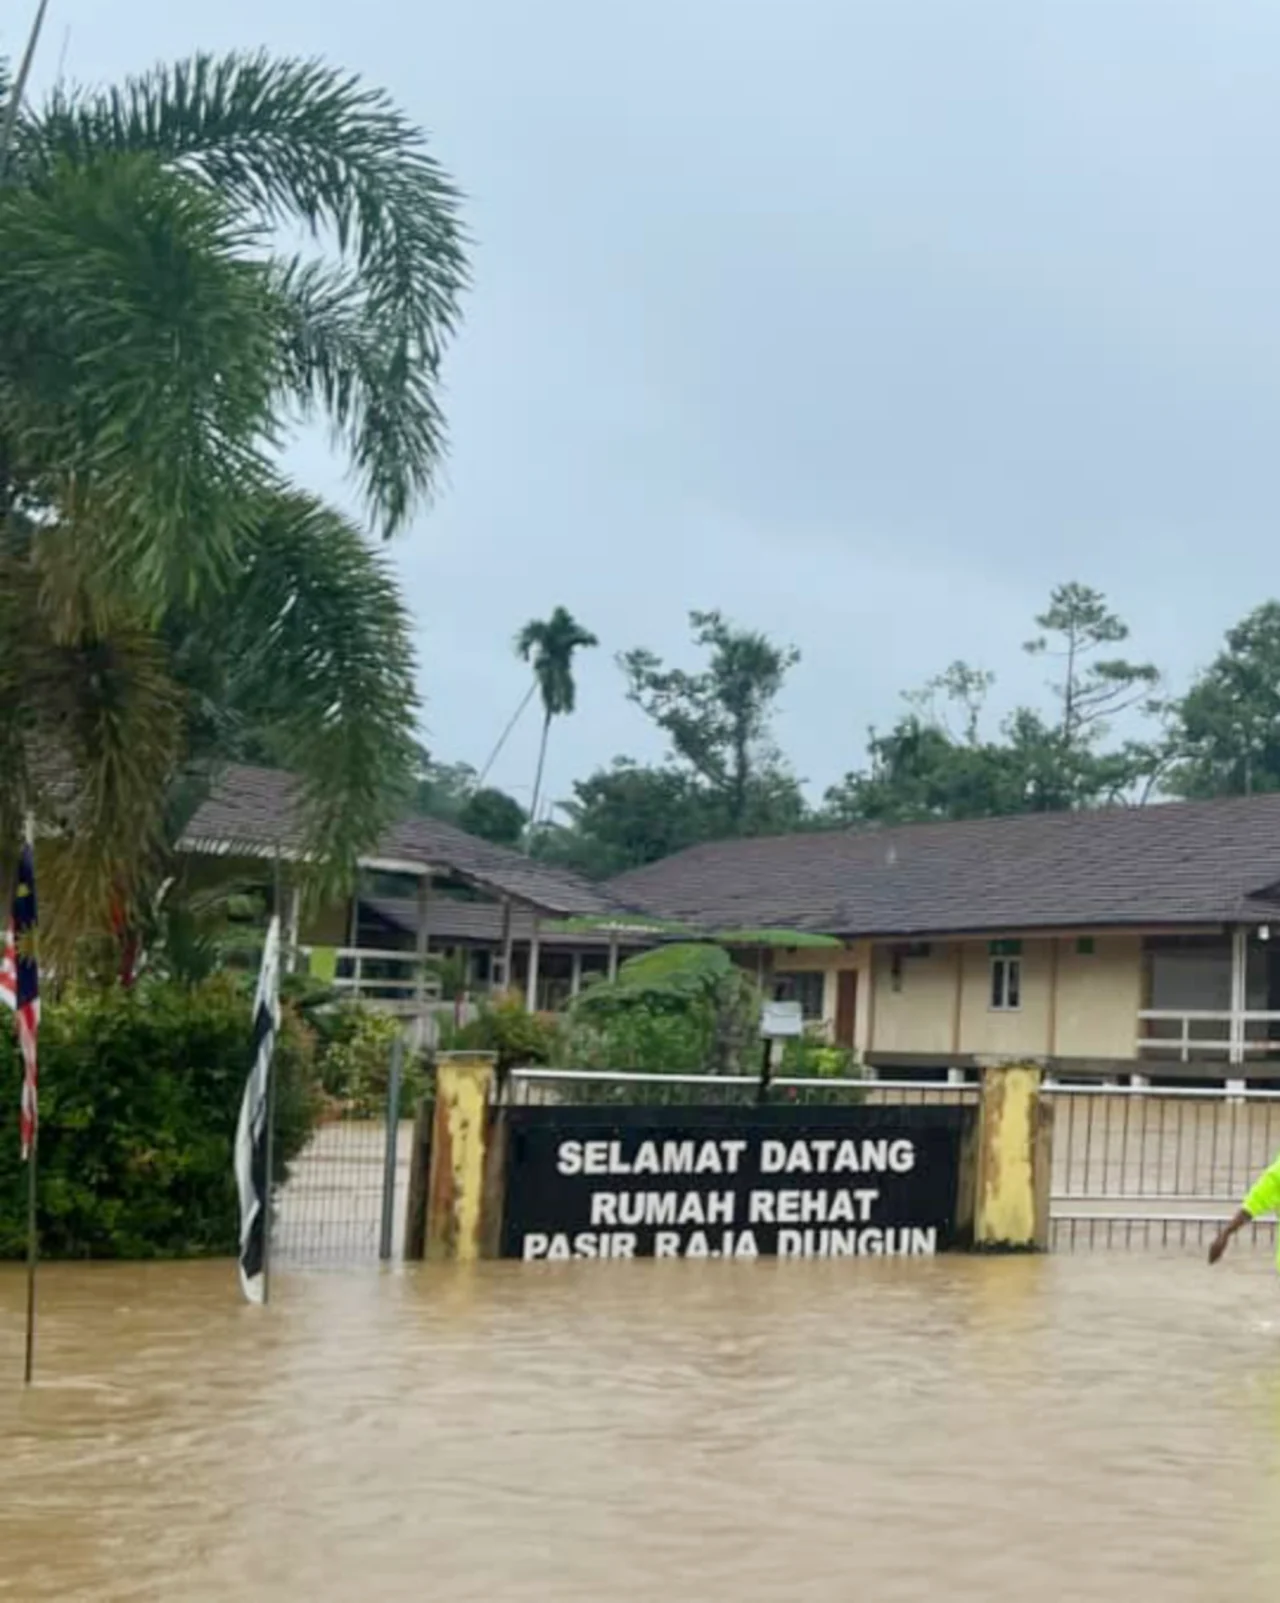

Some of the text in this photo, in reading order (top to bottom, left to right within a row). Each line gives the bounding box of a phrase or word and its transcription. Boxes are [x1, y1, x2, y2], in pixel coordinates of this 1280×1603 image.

[558, 1139, 914, 1173] SELAMAT DATANG
[591, 1190, 879, 1225] RUMAH REHAT
[523, 1227, 936, 1260] PASIR RAJA DUNGUN
